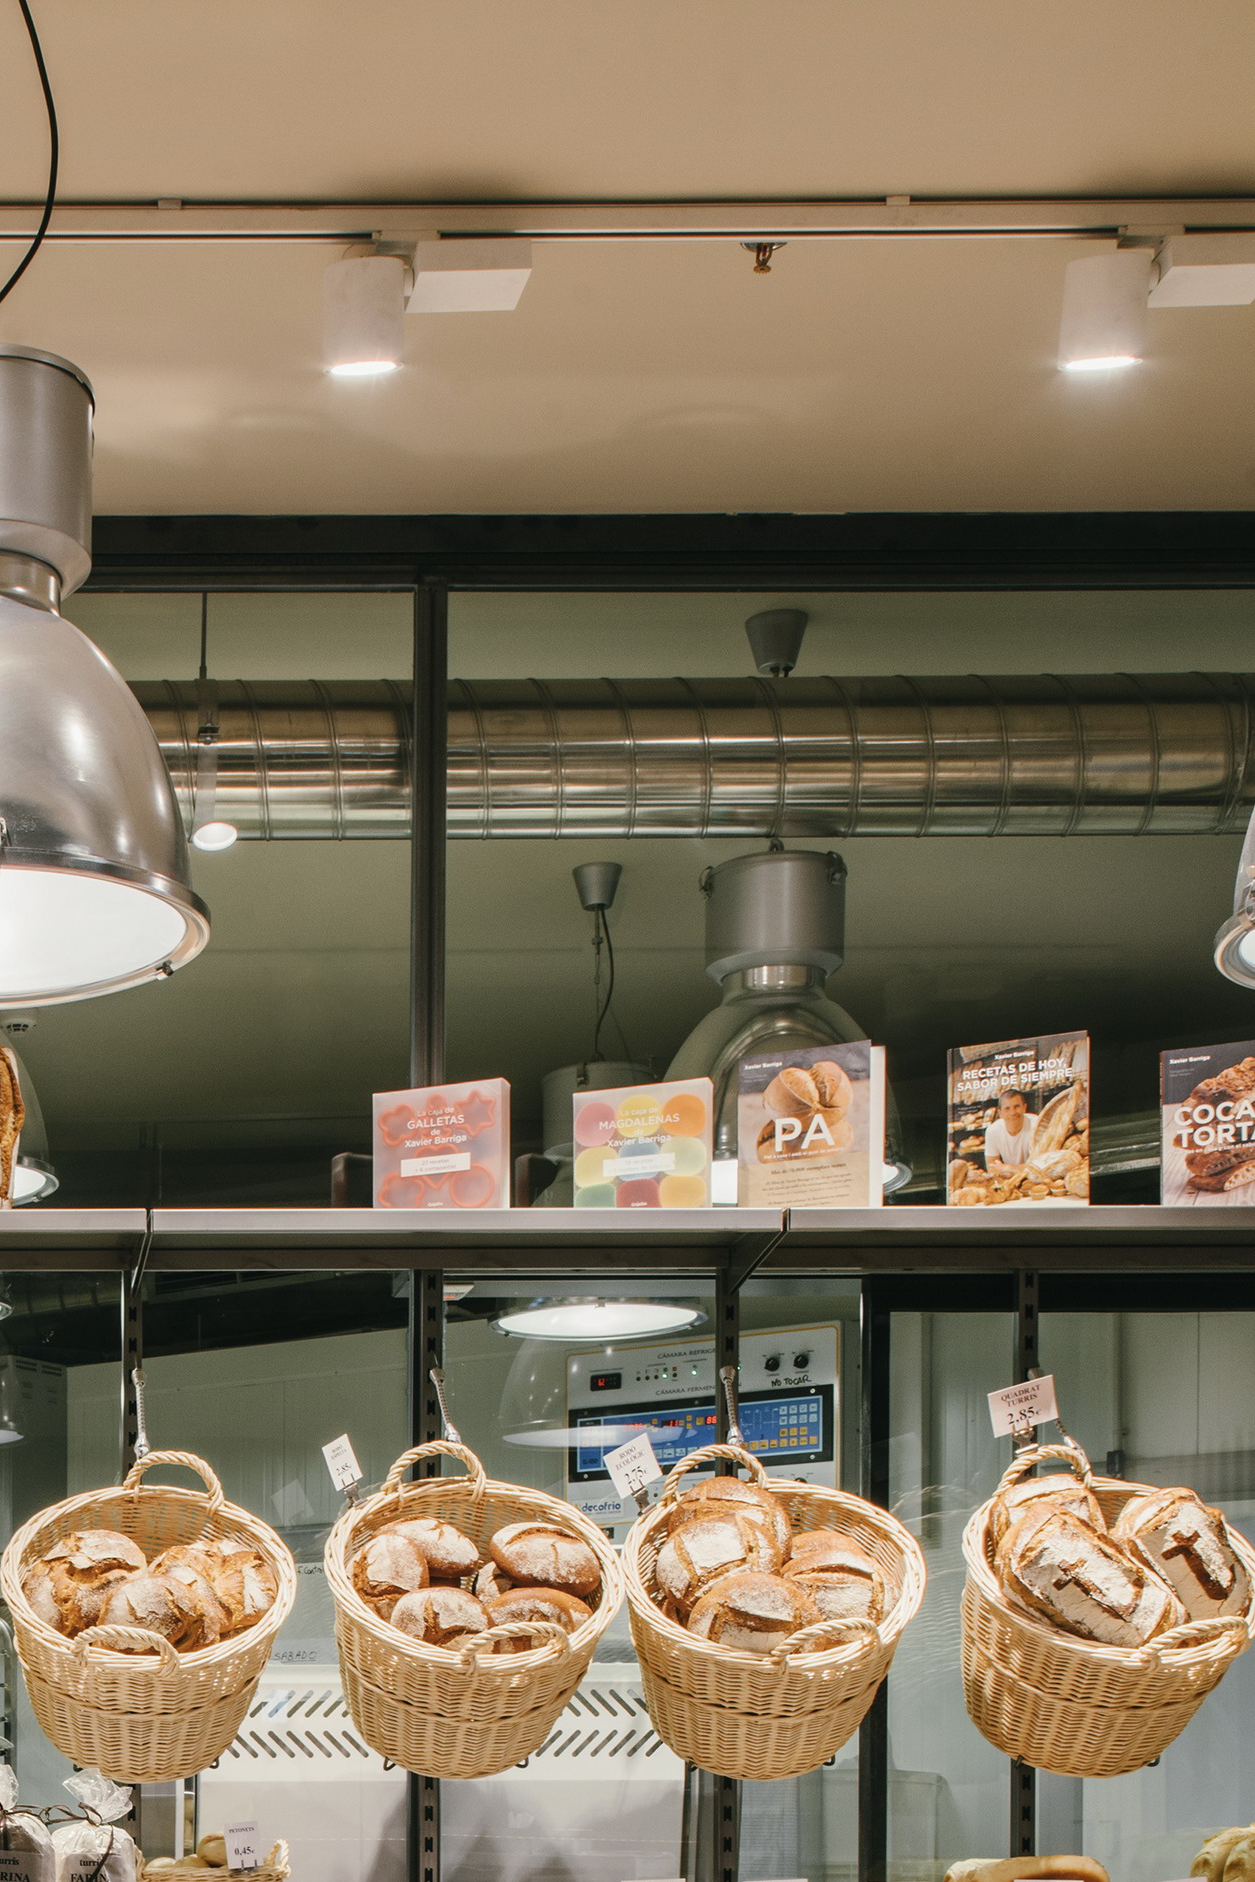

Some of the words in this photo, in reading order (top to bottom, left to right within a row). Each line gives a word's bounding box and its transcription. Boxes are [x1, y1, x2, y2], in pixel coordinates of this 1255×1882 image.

[963, 1065, 1016, 1080] RECETAS
[1019, 1062, 1036, 1073] DE
[1038, 1058, 1067, 1070] HOY,
[957, 1078, 998, 1092] SABOR
[1001, 1075, 1018, 1085] DE
[1020, 1068, 1073, 1083] SIEMPRE
[428, 1109, 443, 1117] caja
[407, 1114, 465, 1129] GALLETAS
[599, 1113, 680, 1130] MAGDALENAS
[775, 1113, 835, 1152] PA
[1176, 1121, 1255, 1148] TORT
[405, 1138, 432, 1148] Xavier
[434, 1134, 467, 1145] Barriga
[607, 1138, 635, 1148] Xavier
[638, 1134, 672, 1145] Barriga
[771, 1378, 782, 1388] NO
[785, 1374, 812, 1386] TOCAR
[1001, 1384, 1041, 1401] QUADRAT
[1007, 1393, 1037, 1407] TURRIS
[1007, 1406, 1041, 1424] 2,85€
[582, 1501, 621, 1512] decofrio
[80, 1858, 102, 1867] turri
